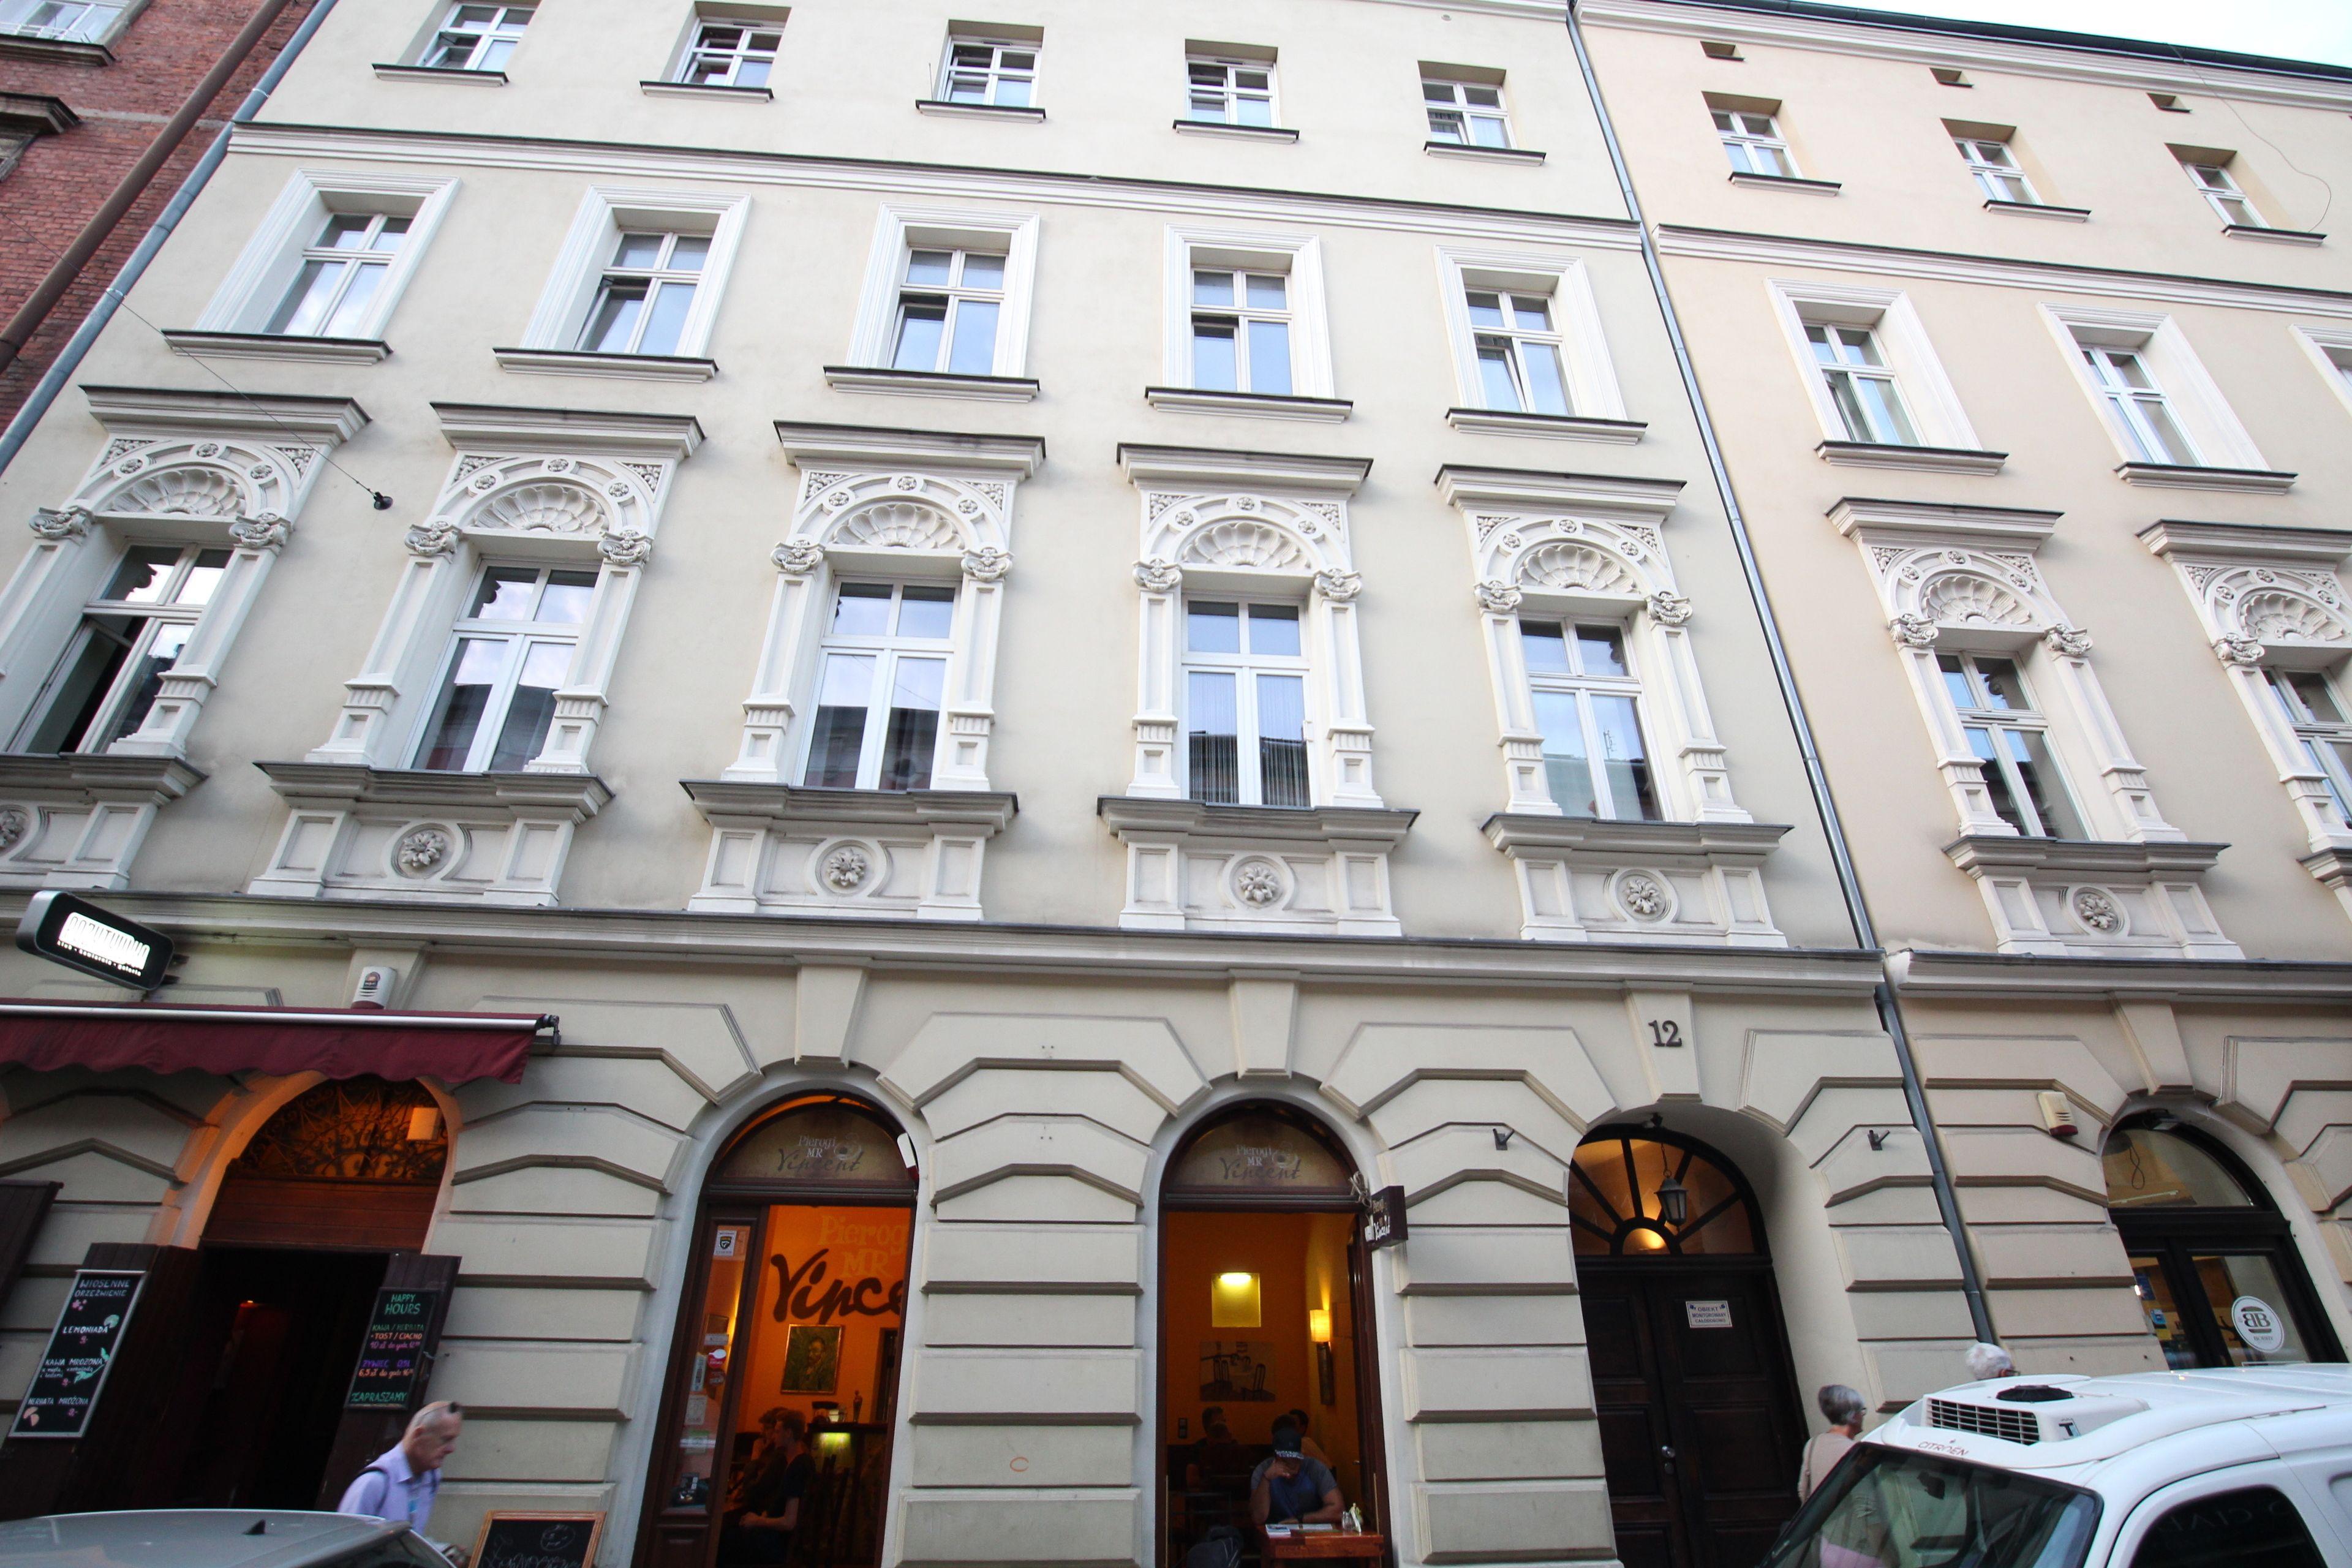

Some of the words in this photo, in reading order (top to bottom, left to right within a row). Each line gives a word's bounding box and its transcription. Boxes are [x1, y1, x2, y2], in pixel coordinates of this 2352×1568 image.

[1648, 1019, 1683, 1047] 12
[798, 1135, 837, 1150] Pierogi
[806, 1148, 823, 1158] MR
[1237, 1144, 1272, 1158] Pierogi
[777, 1148, 864, 1172] Vincent
[1247, 1156, 1263, 1166] MR
[1219, 1157, 1302, 1180] Vincent
[839, 1248, 889, 1278] MR
[79, 1280, 130, 1288] WIOSENNE
[391, 1294, 417, 1303] HAPPY
[384, 1303, 421, 1315] HOURS
